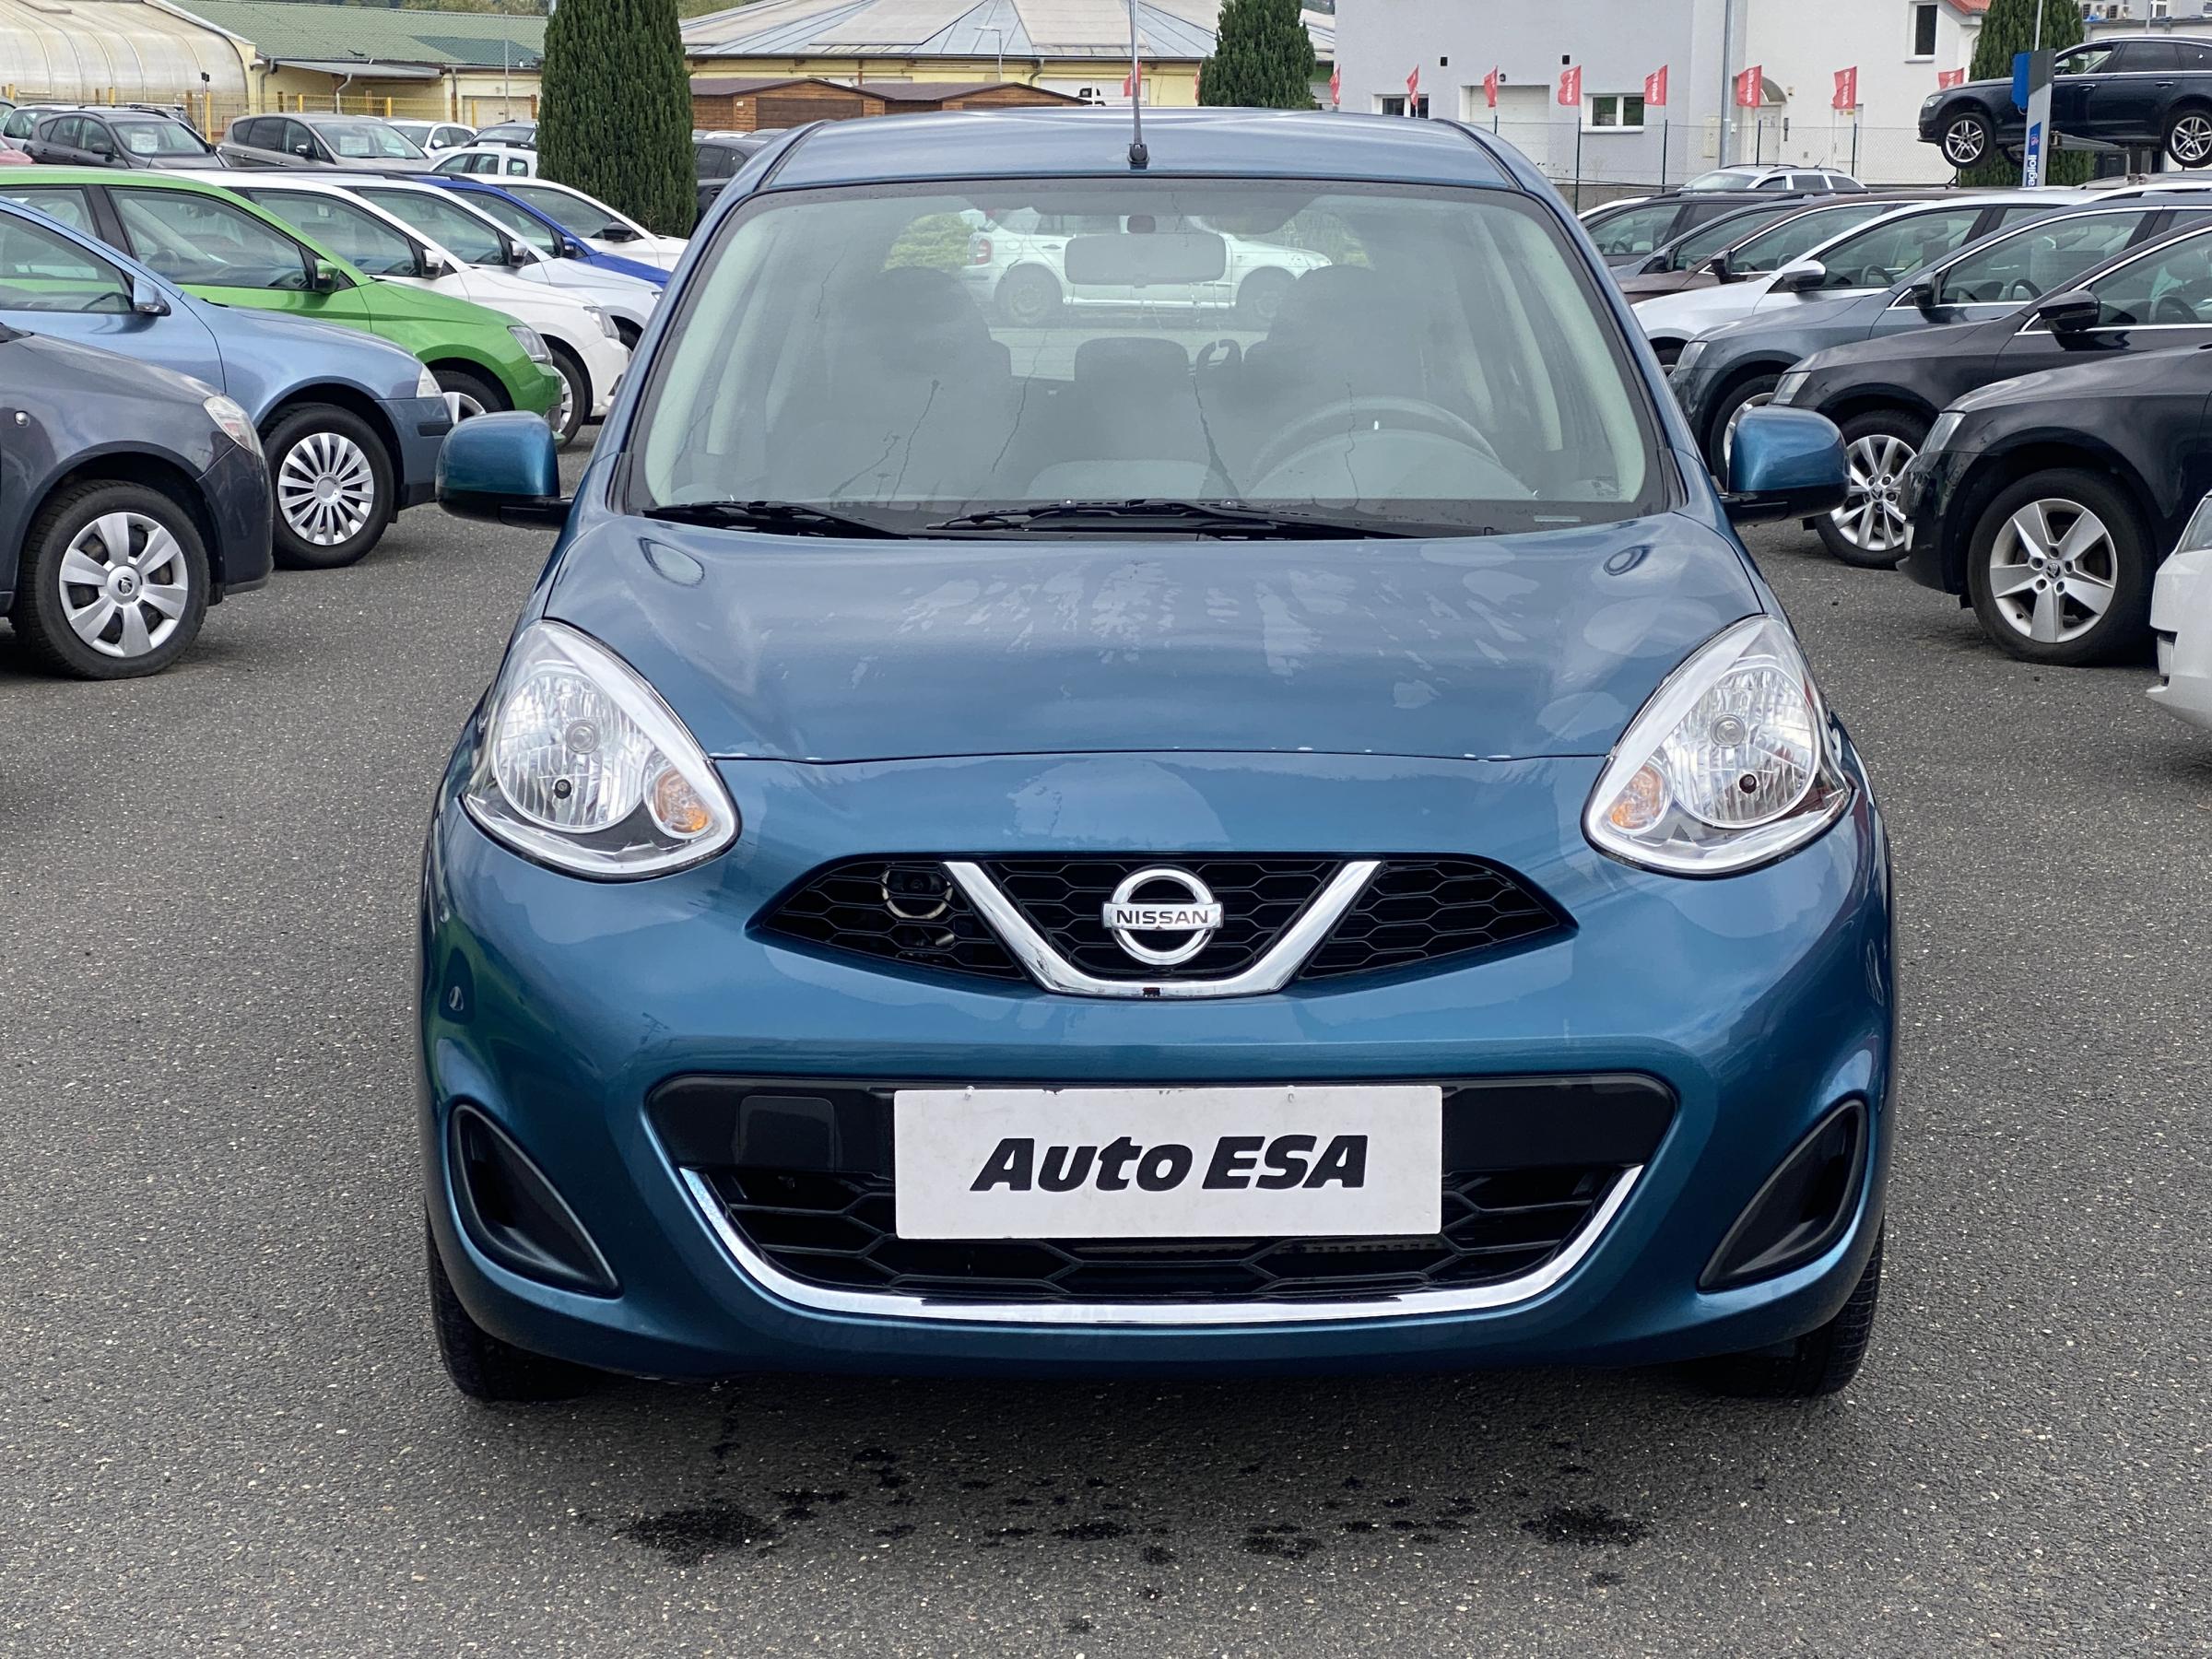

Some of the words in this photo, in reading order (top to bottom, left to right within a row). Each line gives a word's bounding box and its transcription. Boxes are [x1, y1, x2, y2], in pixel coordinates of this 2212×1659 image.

[2028, 155, 2037, 186] aglioli
[1116, 910, 1208, 924] NISSAN
[970, 1136, 1194, 1192] Auto
[1202, 1134, 1369, 1189] ESA
